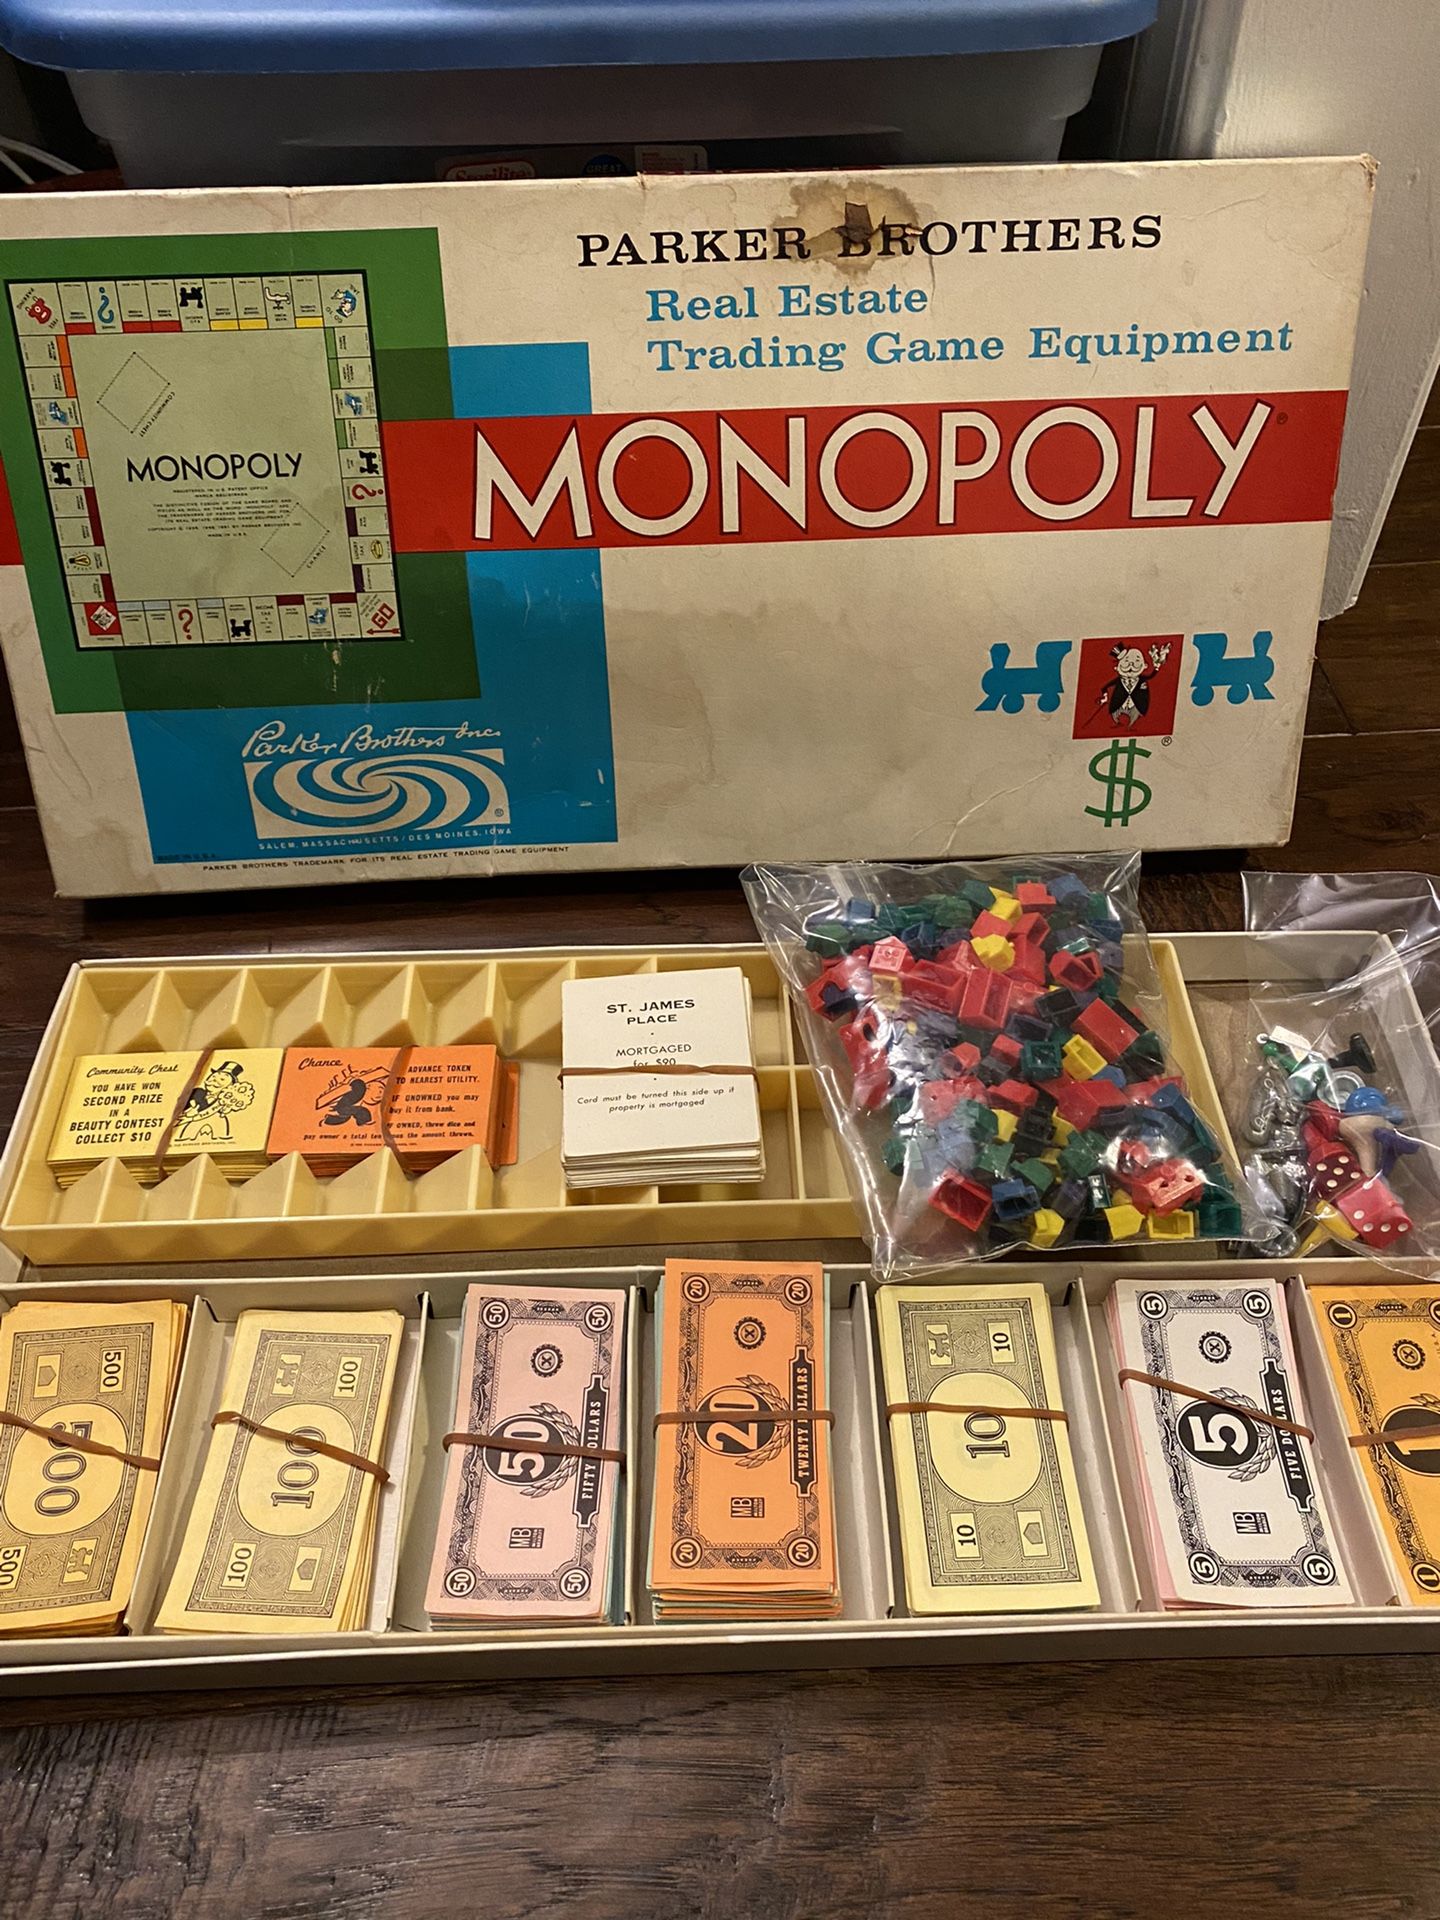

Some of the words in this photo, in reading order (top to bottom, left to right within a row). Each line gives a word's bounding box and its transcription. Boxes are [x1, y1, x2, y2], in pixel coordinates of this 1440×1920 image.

[577, 227, 812, 267] PARKER
[646, 287, 757, 322] Real
[778, 282, 929, 317] Estate
[647, 337, 847, 372] Trading
[866, 331, 1005, 364] Game
[1029, 321, 1294, 364] Equipment
[126, 452, 303, 482] MONOPOLY
[474, 401, 1273, 541] MONOPOLY
[241, 719, 337, 757] Parker
[339, 723, 446, 754] Brothers
[243, 861, 288, 869] BROTHERS
[293, 859, 345, 867] TRADEMARK
[417, 852, 449, 860] ESTATE
[453, 849, 490, 857] TRADING
[522, 846, 569, 854] EQUIPMENT
[606, 1003, 632, 1014] ST.
[639, 999, 696, 1012] JAMES
[626, 1014, 678, 1025] PLACE
[615, 1043, 692, 1057] MORTGAGED
[86, 1065, 146, 1078] Community
[148, 1064, 180, 1075] Chest
[298, 1057, 343, 1070] Chance
[408, 1065, 442, 1073] ADVANCE
[447, 1064, 472, 1072] TOKEN
[91, 1084, 110, 1093] YOU
[114, 1083, 136, 1092] HAVE
[142, 1082, 161, 1091] WON
[396, 1077, 406, 1085] TO
[409, 1076, 443, 1084] NEAREST
[446, 1075, 480, 1083] UTILITY.
[83, 1096, 126, 1107] SECOND
[131, 1094, 164, 1104] PRIZE
[392, 1094, 400, 1102] IF
[577, 1096, 598, 1105] Card
[602, 1094, 622, 1103] must
[626, 1093, 637, 1101] be
[641, 1091, 669, 1100] turned
[672, 1089, 688, 1097] this
[692, 1087, 709, 1096] side
[713, 1087, 725, 1096] up
[608, 1102, 646, 1114] property
[659, 1098, 705, 1110] mortgaged
[109, 1109, 120, 1117] IN
[123, 1108, 130, 1117] A
[415, 1105, 433, 1113] from
[70, 1120, 112, 1132] BEAUTY
[115, 1118, 165, 1129] CONTEST
[75, 1133, 126, 1145] COLLECT
[689, 1280, 704, 1296] 20
[791, 1282, 805, 1299] 20
[489, 1303, 504, 1324] 50
[1144, 1298, 1162, 1312] 5
[1247, 1297, 1265, 1311] 5
[590, 1308, 606, 1329] 50
[991, 1331, 1012, 1352] 10
[102, 1350, 122, 1388] 500
[338, 1359, 359, 1394] 100
[586, 1400, 602, 1449] OLLARS
[706, 1389, 760, 1451] 20
[1270, 1388, 1293, 1446] DOLARS
[964, 1411, 1011, 1459] 10
[1190, 1412, 1249, 1457] 5
[497, 1419, 550, 1479] 50
[797, 1427, 810, 1478] TWENTY
[270, 1425, 327, 1510] 100
[1284, 1450, 1303, 1480] FIVE
[581, 1463, 596, 1500] FIFTY
[956, 1524, 977, 1547] 10
[679, 1544, 694, 1561] 20
[795, 1543, 809, 1560] 20
[226, 1546, 253, 1583] 100
[1196, 1559, 1214, 1575] 5
[1309, 1560, 1328, 1577] 5
[452, 1572, 468, 1593] 50
[566, 1573, 582, 1593] 50
